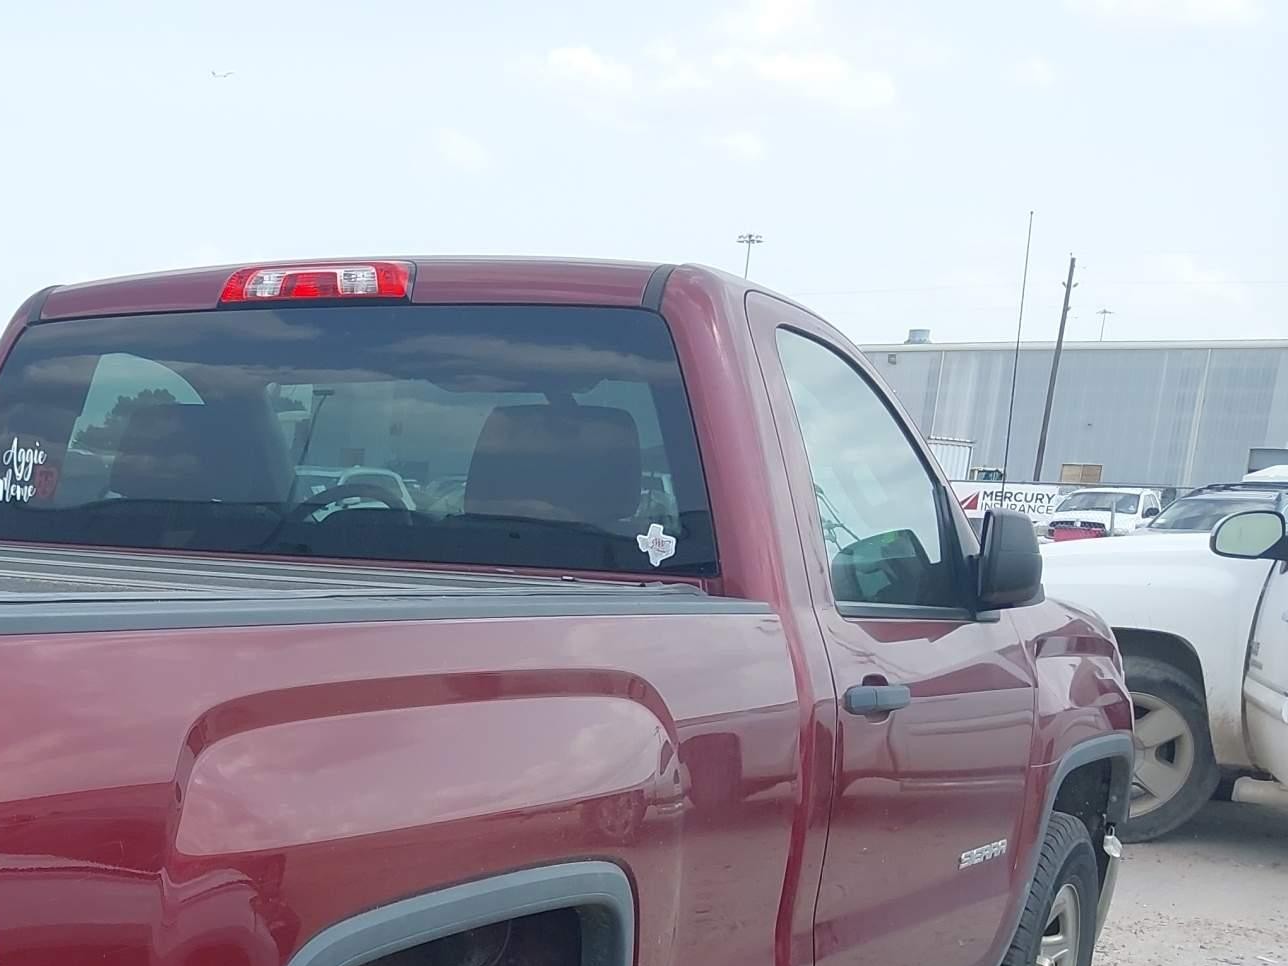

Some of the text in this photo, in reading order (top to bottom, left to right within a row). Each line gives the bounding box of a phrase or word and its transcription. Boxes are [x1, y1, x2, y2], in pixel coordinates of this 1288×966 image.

[2, 436, 48, 482] Aggie
[982, 490, 1056, 505] MERCURY
[958, 838, 1009, 871] SIERRA
